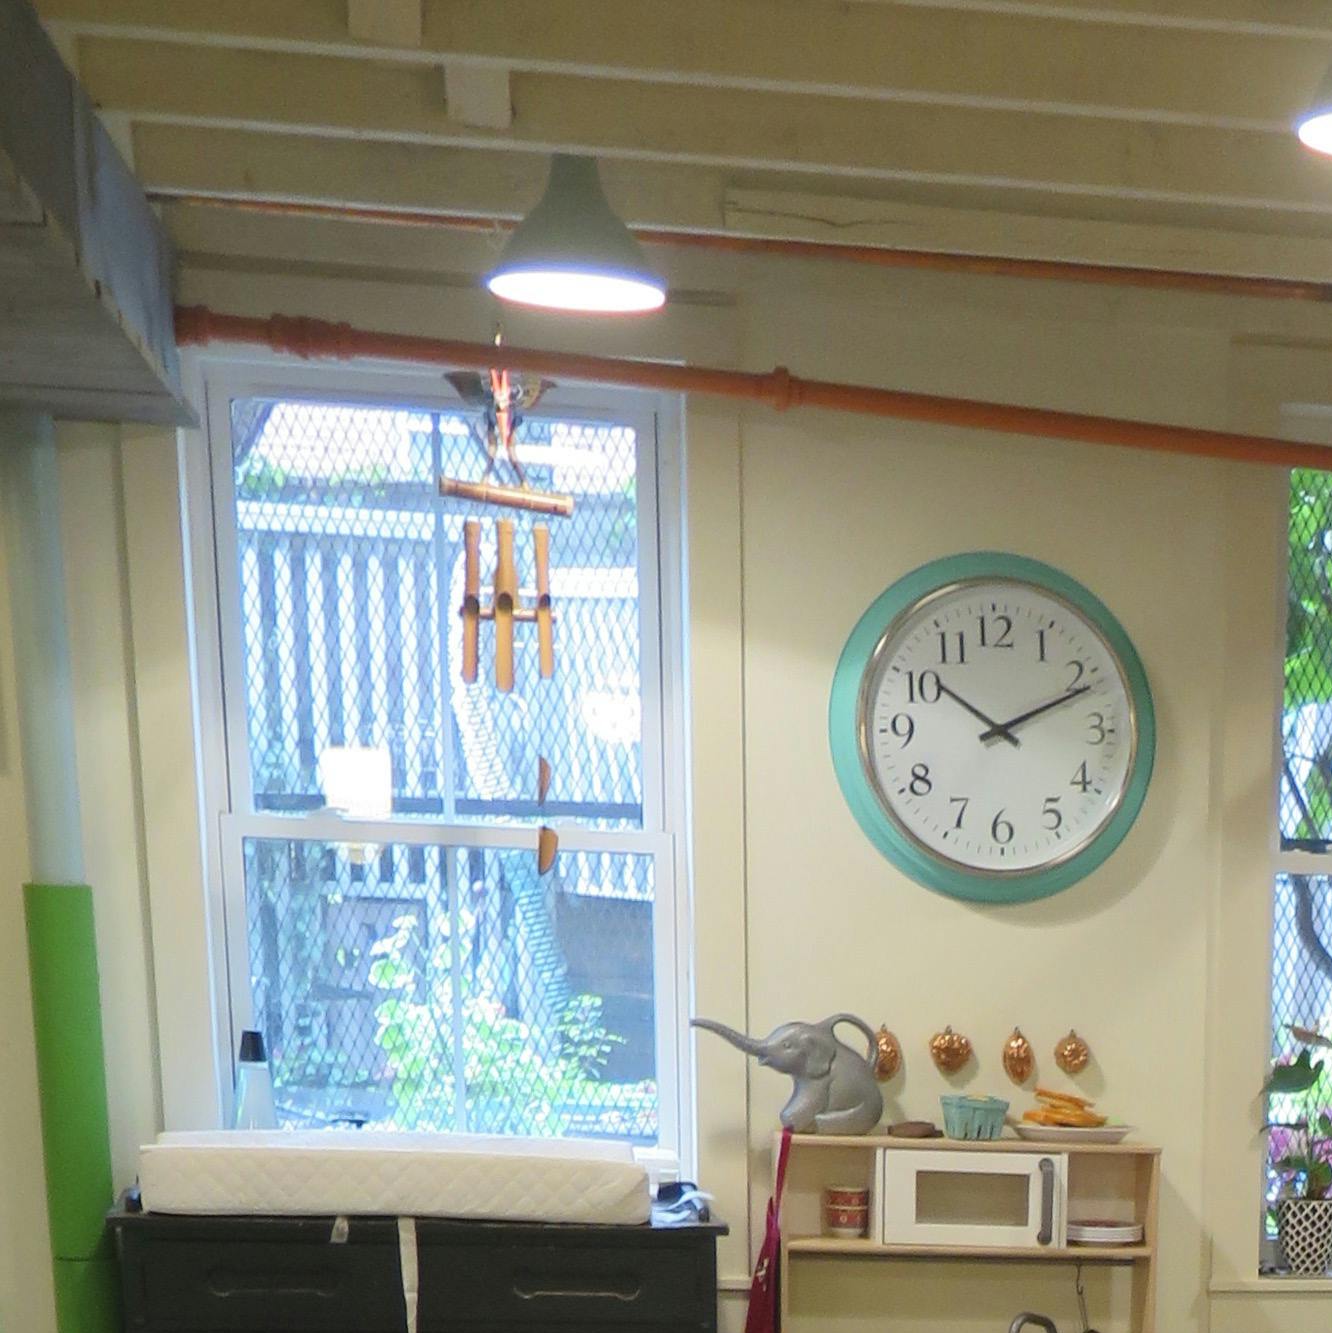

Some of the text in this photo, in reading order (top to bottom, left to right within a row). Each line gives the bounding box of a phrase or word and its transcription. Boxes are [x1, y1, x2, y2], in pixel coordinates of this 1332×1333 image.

[939, 631, 968, 664] 11
[977, 615, 1014, 648] 12
[1036, 629, 1048, 662] 1
[906, 670, 942, 704] 10
[1064, 660, 1088, 692] 2
[890, 713, 915, 749] 9
[1086, 712, 1106, 746] 3
[909, 763, 932, 796] 8
[1070, 760, 1094, 793] 4
[950, 797, 970, 829] 7
[990, 808, 1015, 844] 6
[1042, 796, 1063, 830] 5
